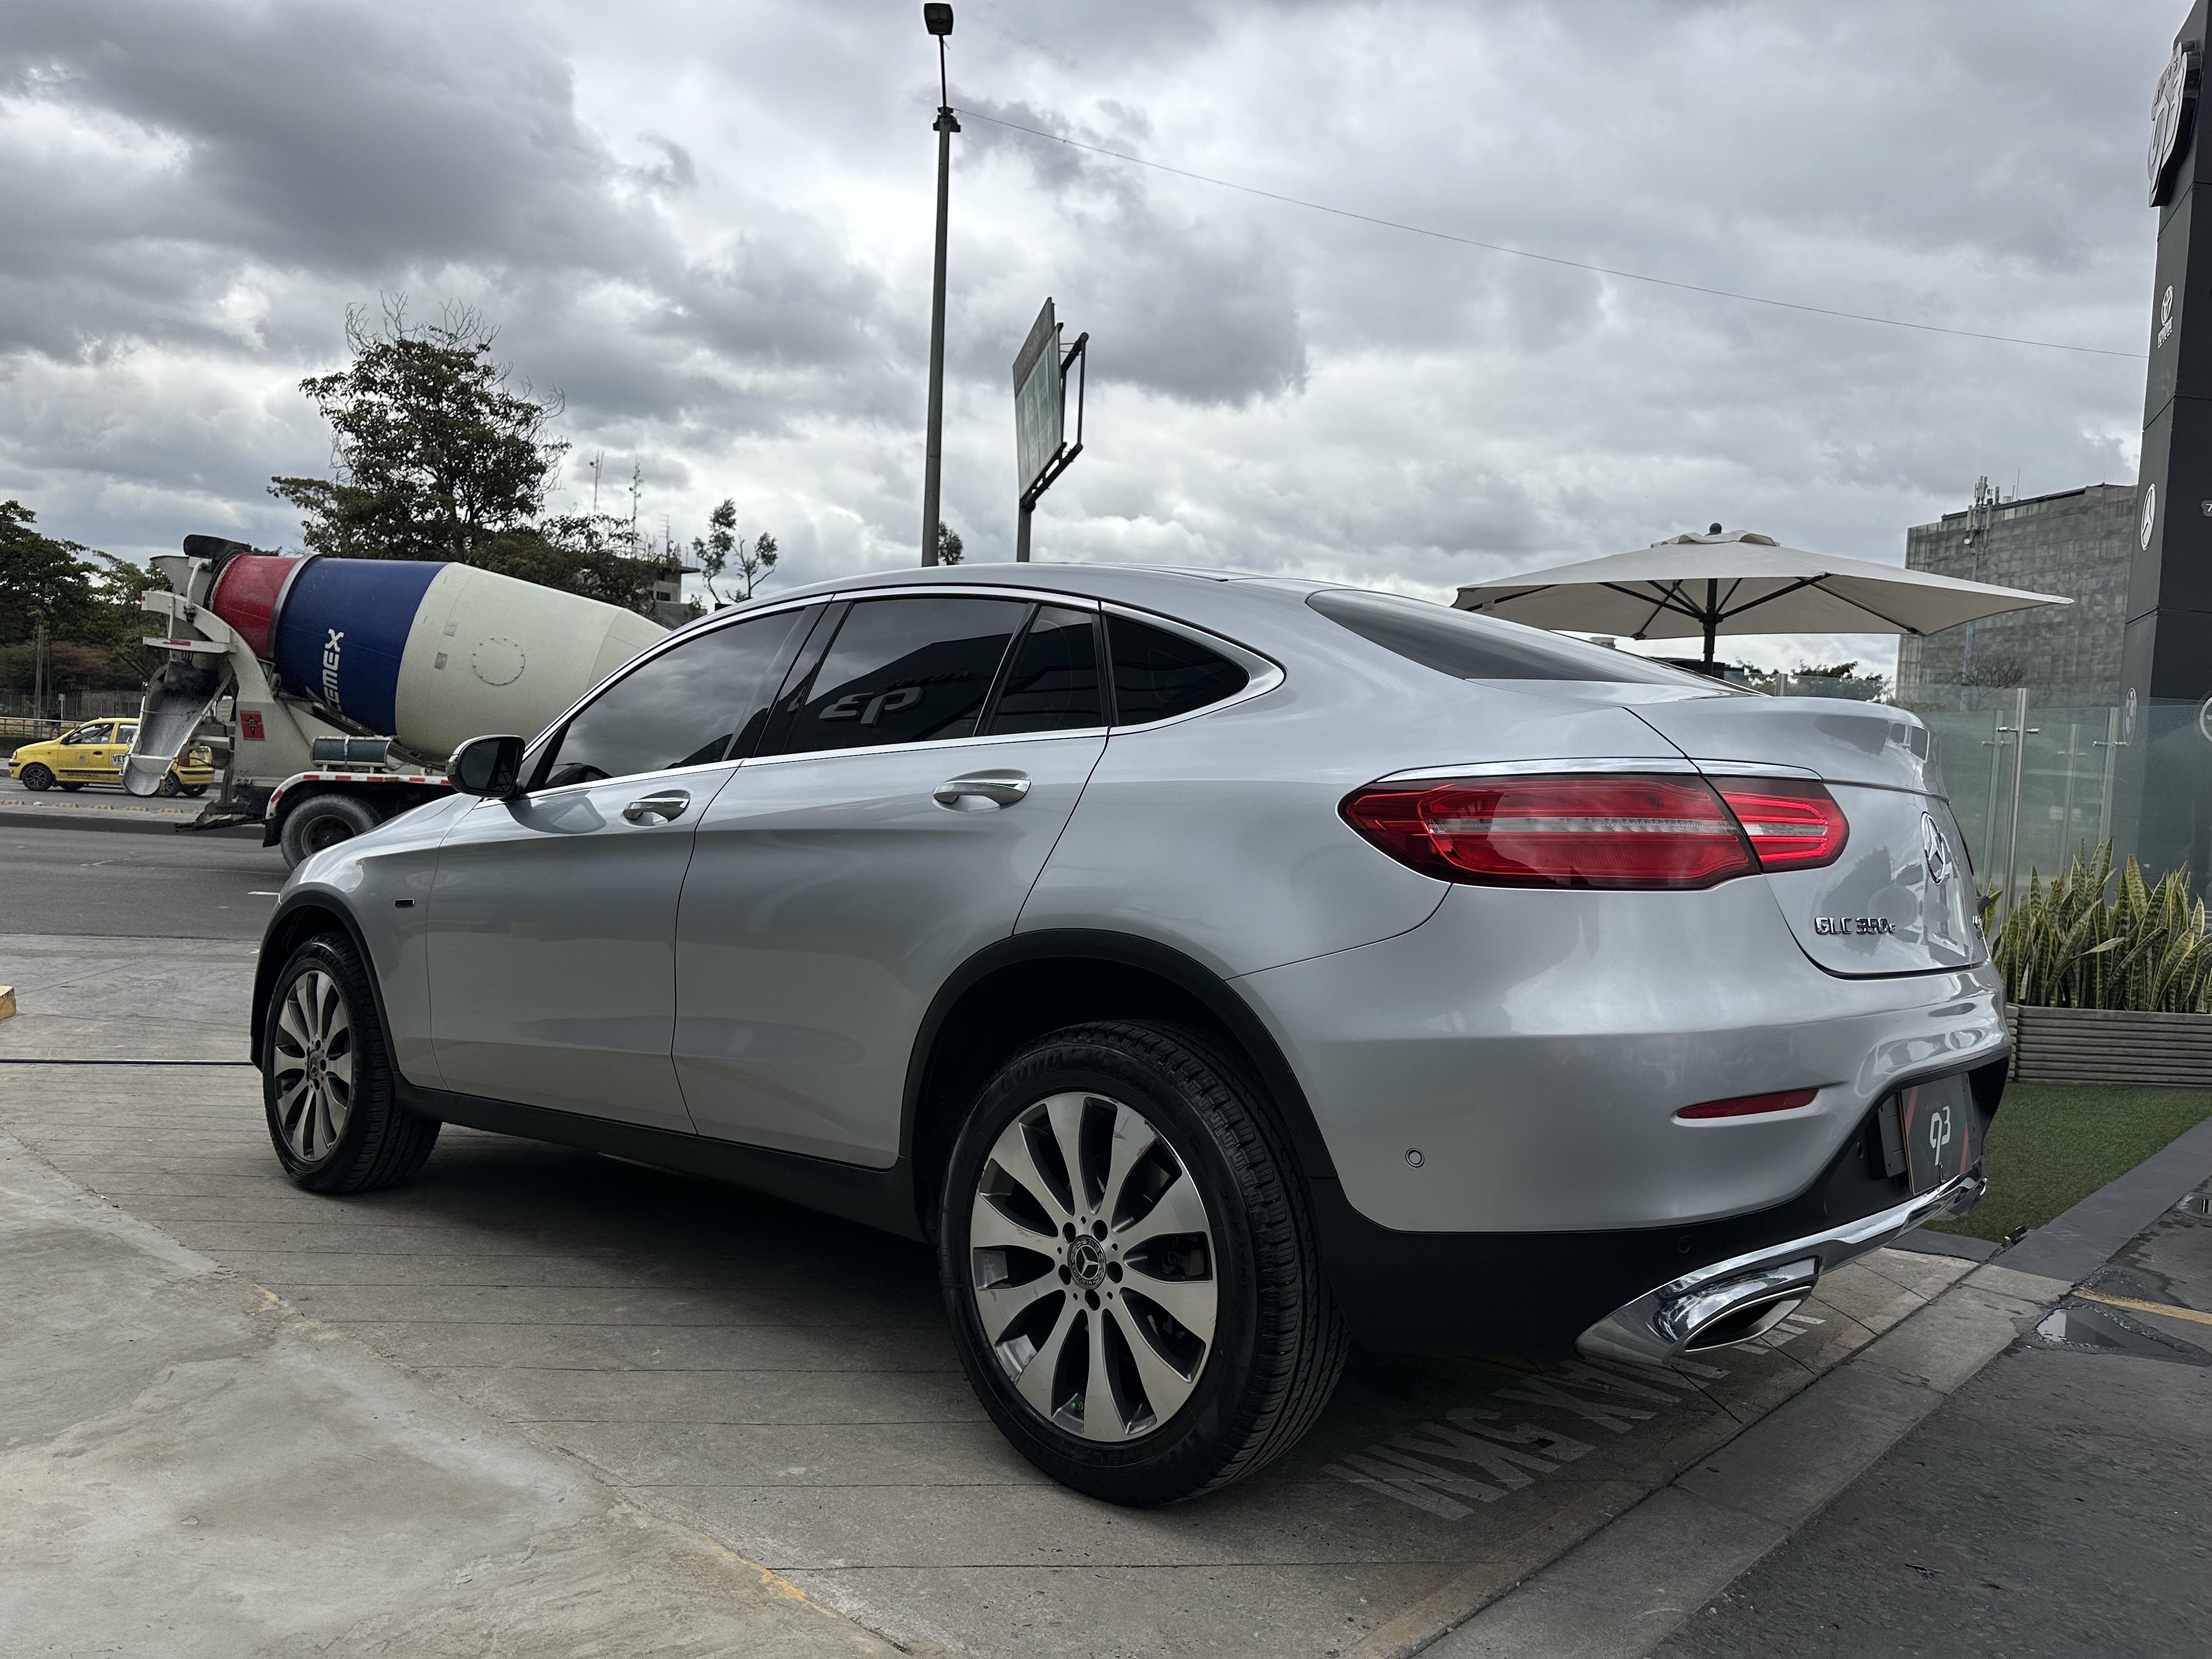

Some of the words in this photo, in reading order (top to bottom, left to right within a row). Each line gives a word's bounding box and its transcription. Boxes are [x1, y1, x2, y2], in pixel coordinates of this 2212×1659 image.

[1815, 917, 1853, 934] GLC
[1855, 917, 1897, 934] 350e
[1929, 1105, 1951, 1167] 93
